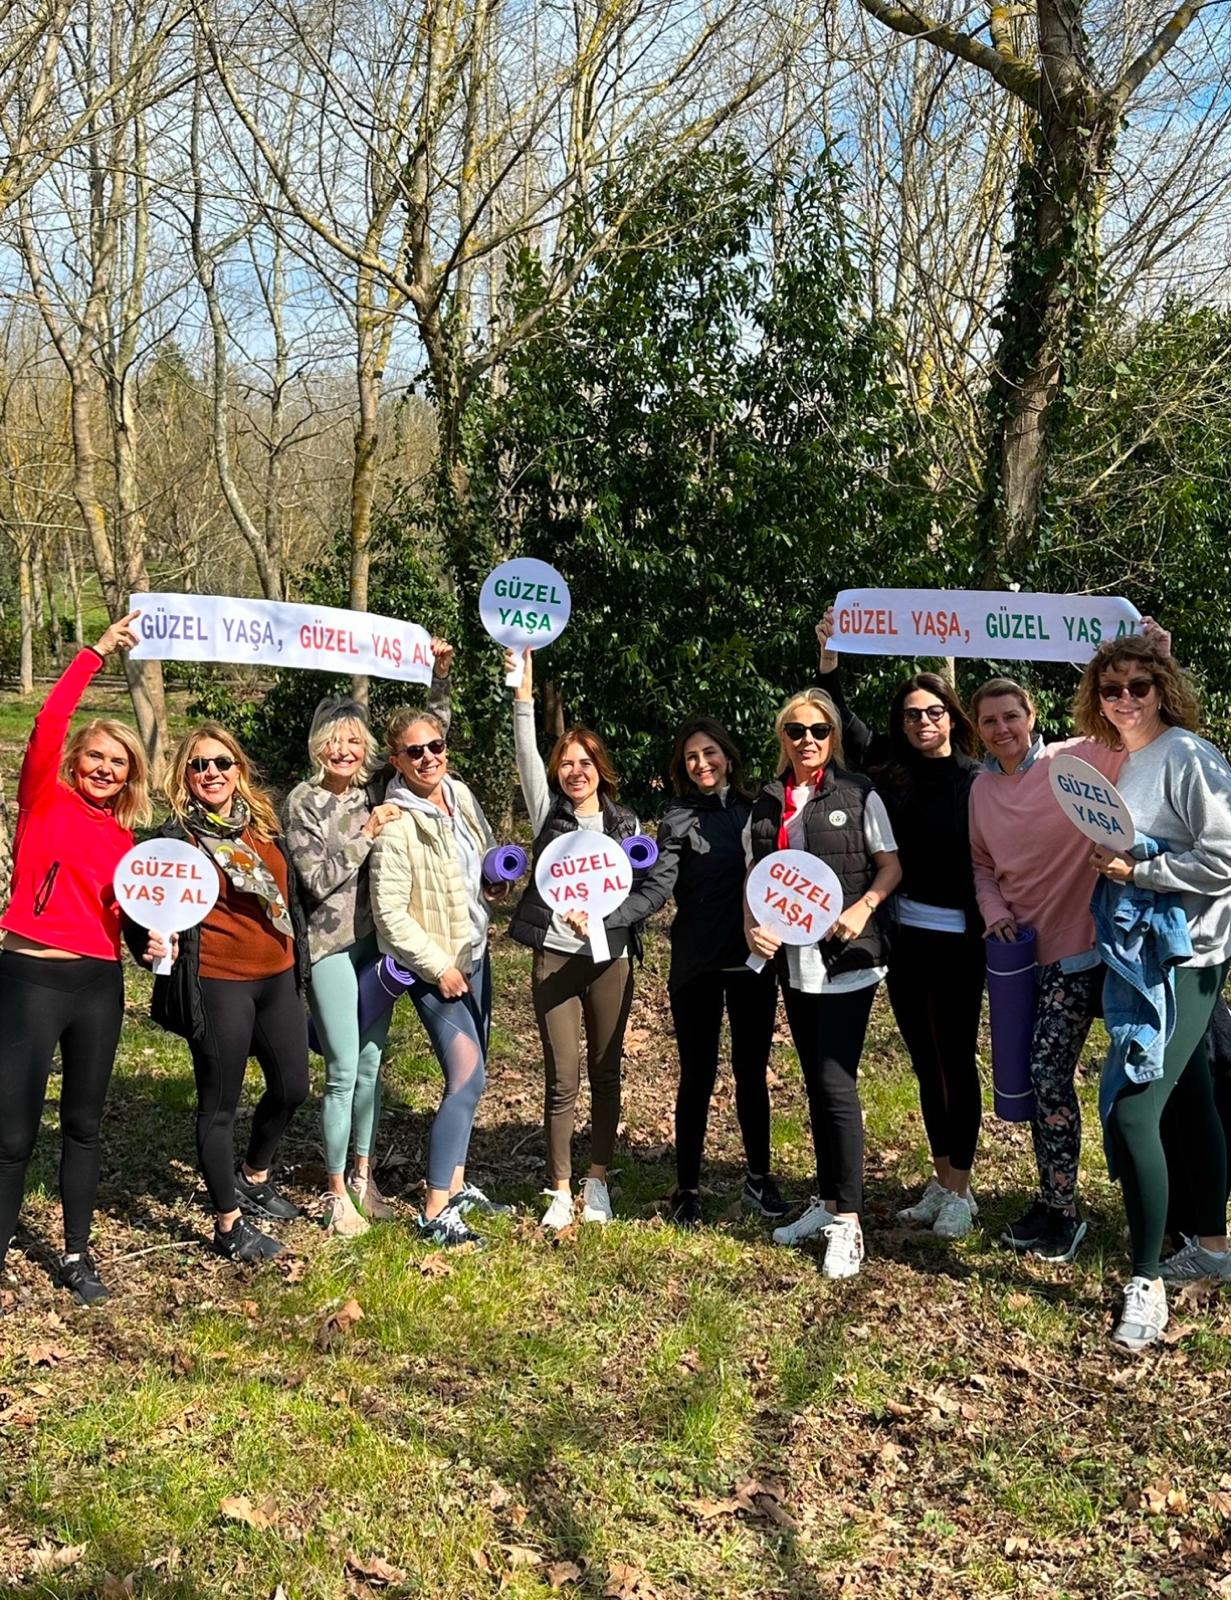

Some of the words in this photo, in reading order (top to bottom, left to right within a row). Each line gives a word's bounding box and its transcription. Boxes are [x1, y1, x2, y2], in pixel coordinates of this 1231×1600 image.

[494, 576, 561, 604] GÜZEL
[498, 607, 552, 634] YAŞA
[839, 602, 898, 635] GÜZEL
[911, 610, 970, 644] YAŞA,
[986, 606, 1050, 640] GÜZEL
[1062, 616, 1102, 651] YAŞ
[141, 607, 208, 640] GÜZEL
[222, 617, 283, 652] YAŞA,
[299, 619, 359, 654] GÜZEL
[371, 633, 402, 668] YAŞ
[412, 643, 430, 667] AL
[1057, 773, 1119, 808] GÜZEL
[1072, 803, 1125, 835] YAŞA
[130, 856, 202, 880] GÜZEL
[550, 852, 616, 879] GÜZEL
[122, 884, 165, 906] YAŞ
[180, 888, 208, 904] AL
[548, 882, 589, 902] YAŞ
[603, 875, 628, 893] AL
[769, 863, 831, 913] GÜZEL
[764, 887, 813, 933] YAŞA
